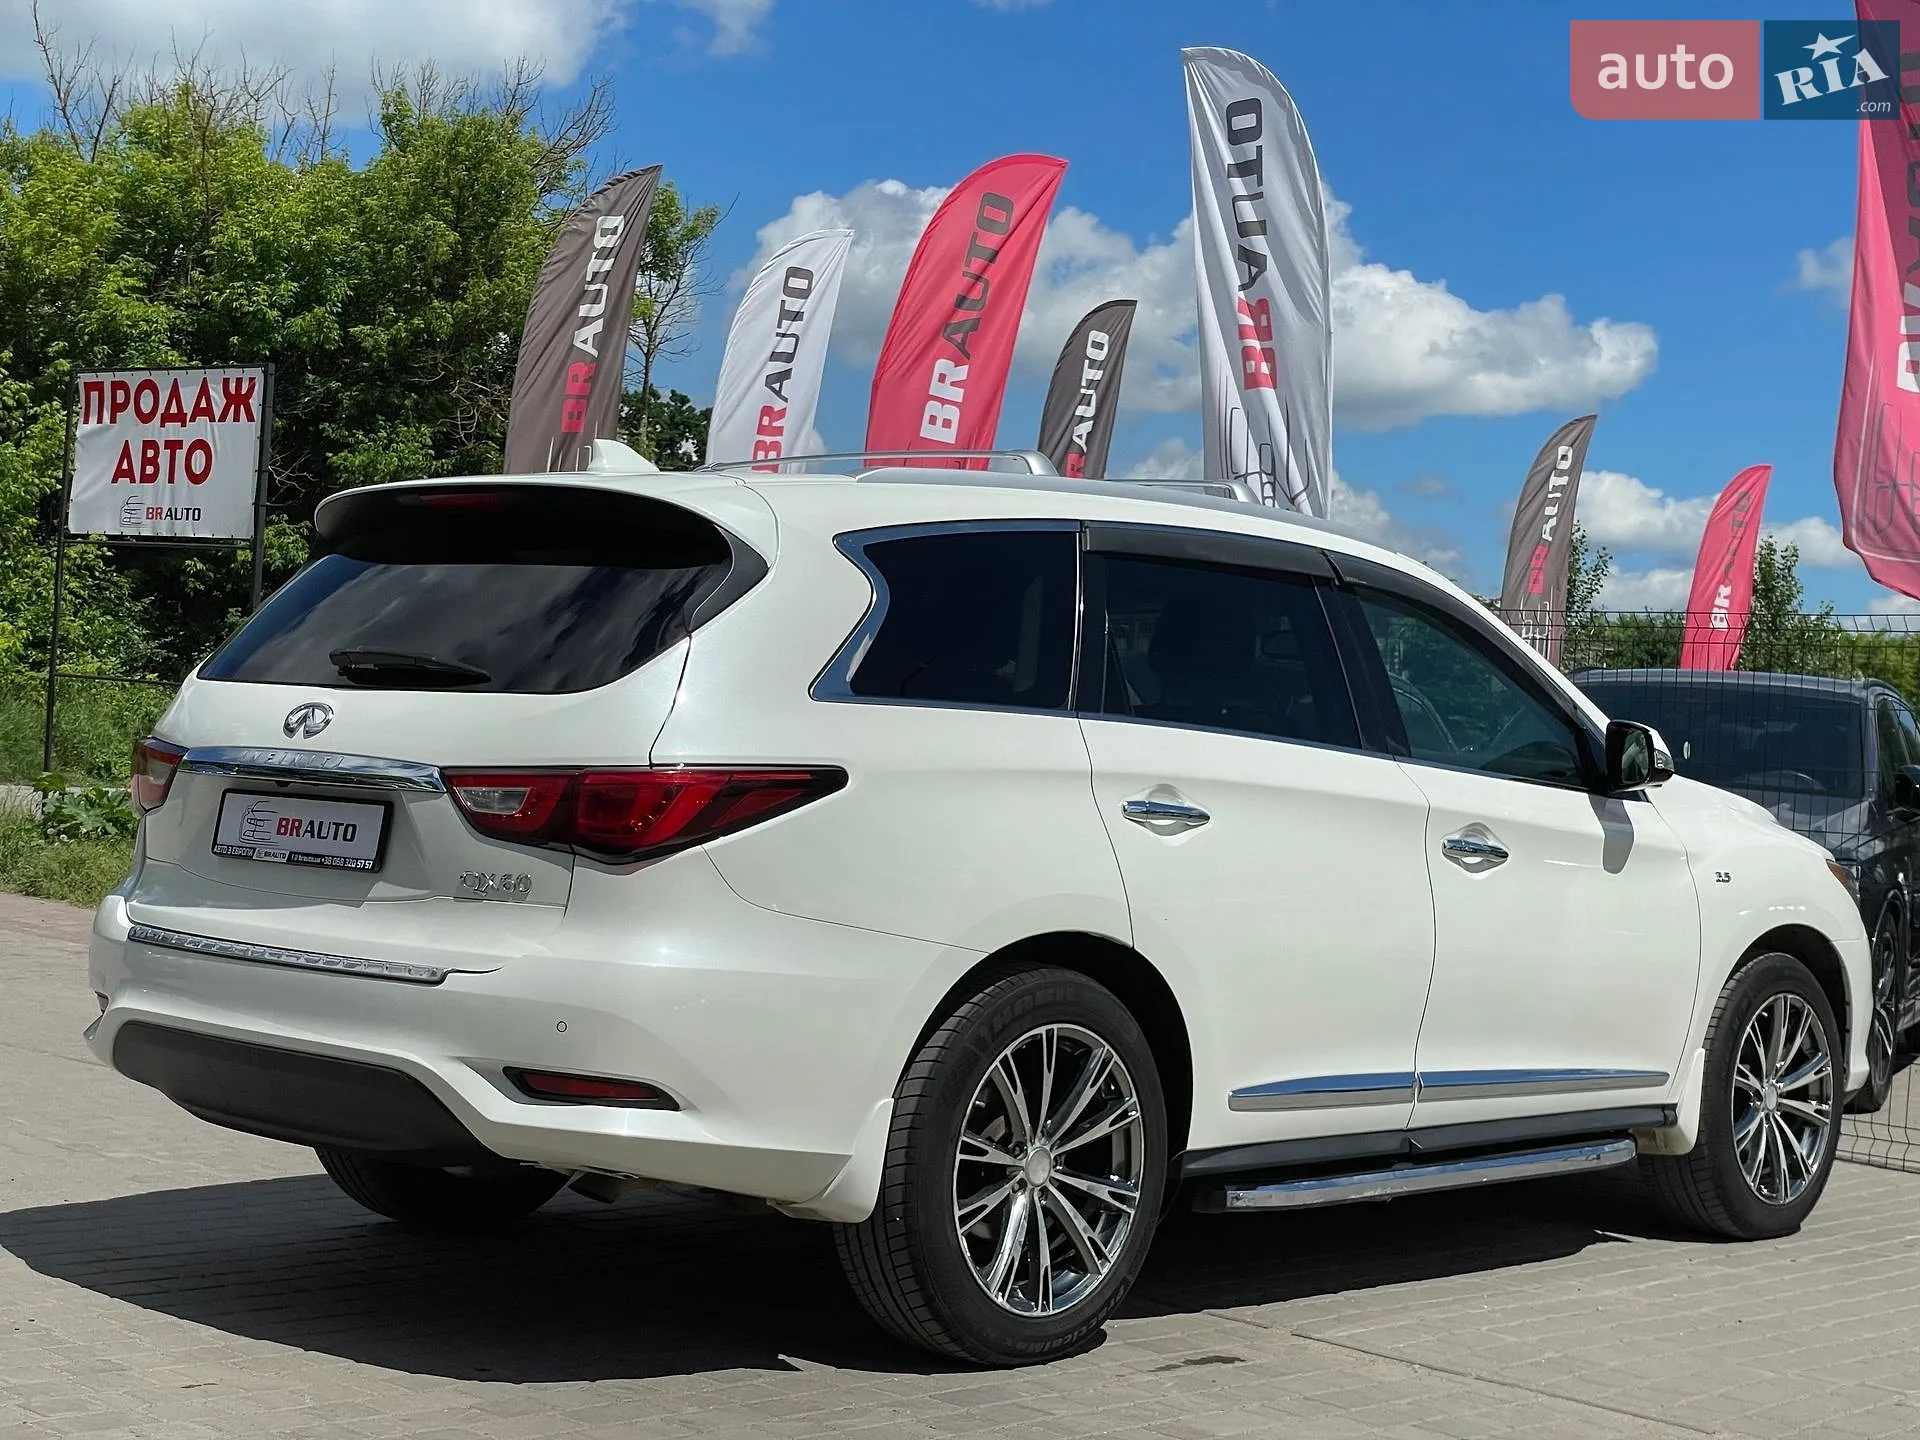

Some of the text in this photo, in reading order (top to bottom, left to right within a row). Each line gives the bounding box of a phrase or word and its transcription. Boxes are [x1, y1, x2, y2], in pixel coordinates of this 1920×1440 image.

[560, 214, 625, 434] BRAUTO
[919, 191, 1014, 444] BRAUTO
[751, 265, 815, 474] BRAUTO
[82, 376, 257, 428] ПРОДАЖ
[111, 438, 213, 486] АВТО
[145, 505, 201, 522] BRAUTO
[276, 817, 357, 843] BRAUTO
[356, 859, 365, 869] 57
[365, 860, 373, 870] 57
